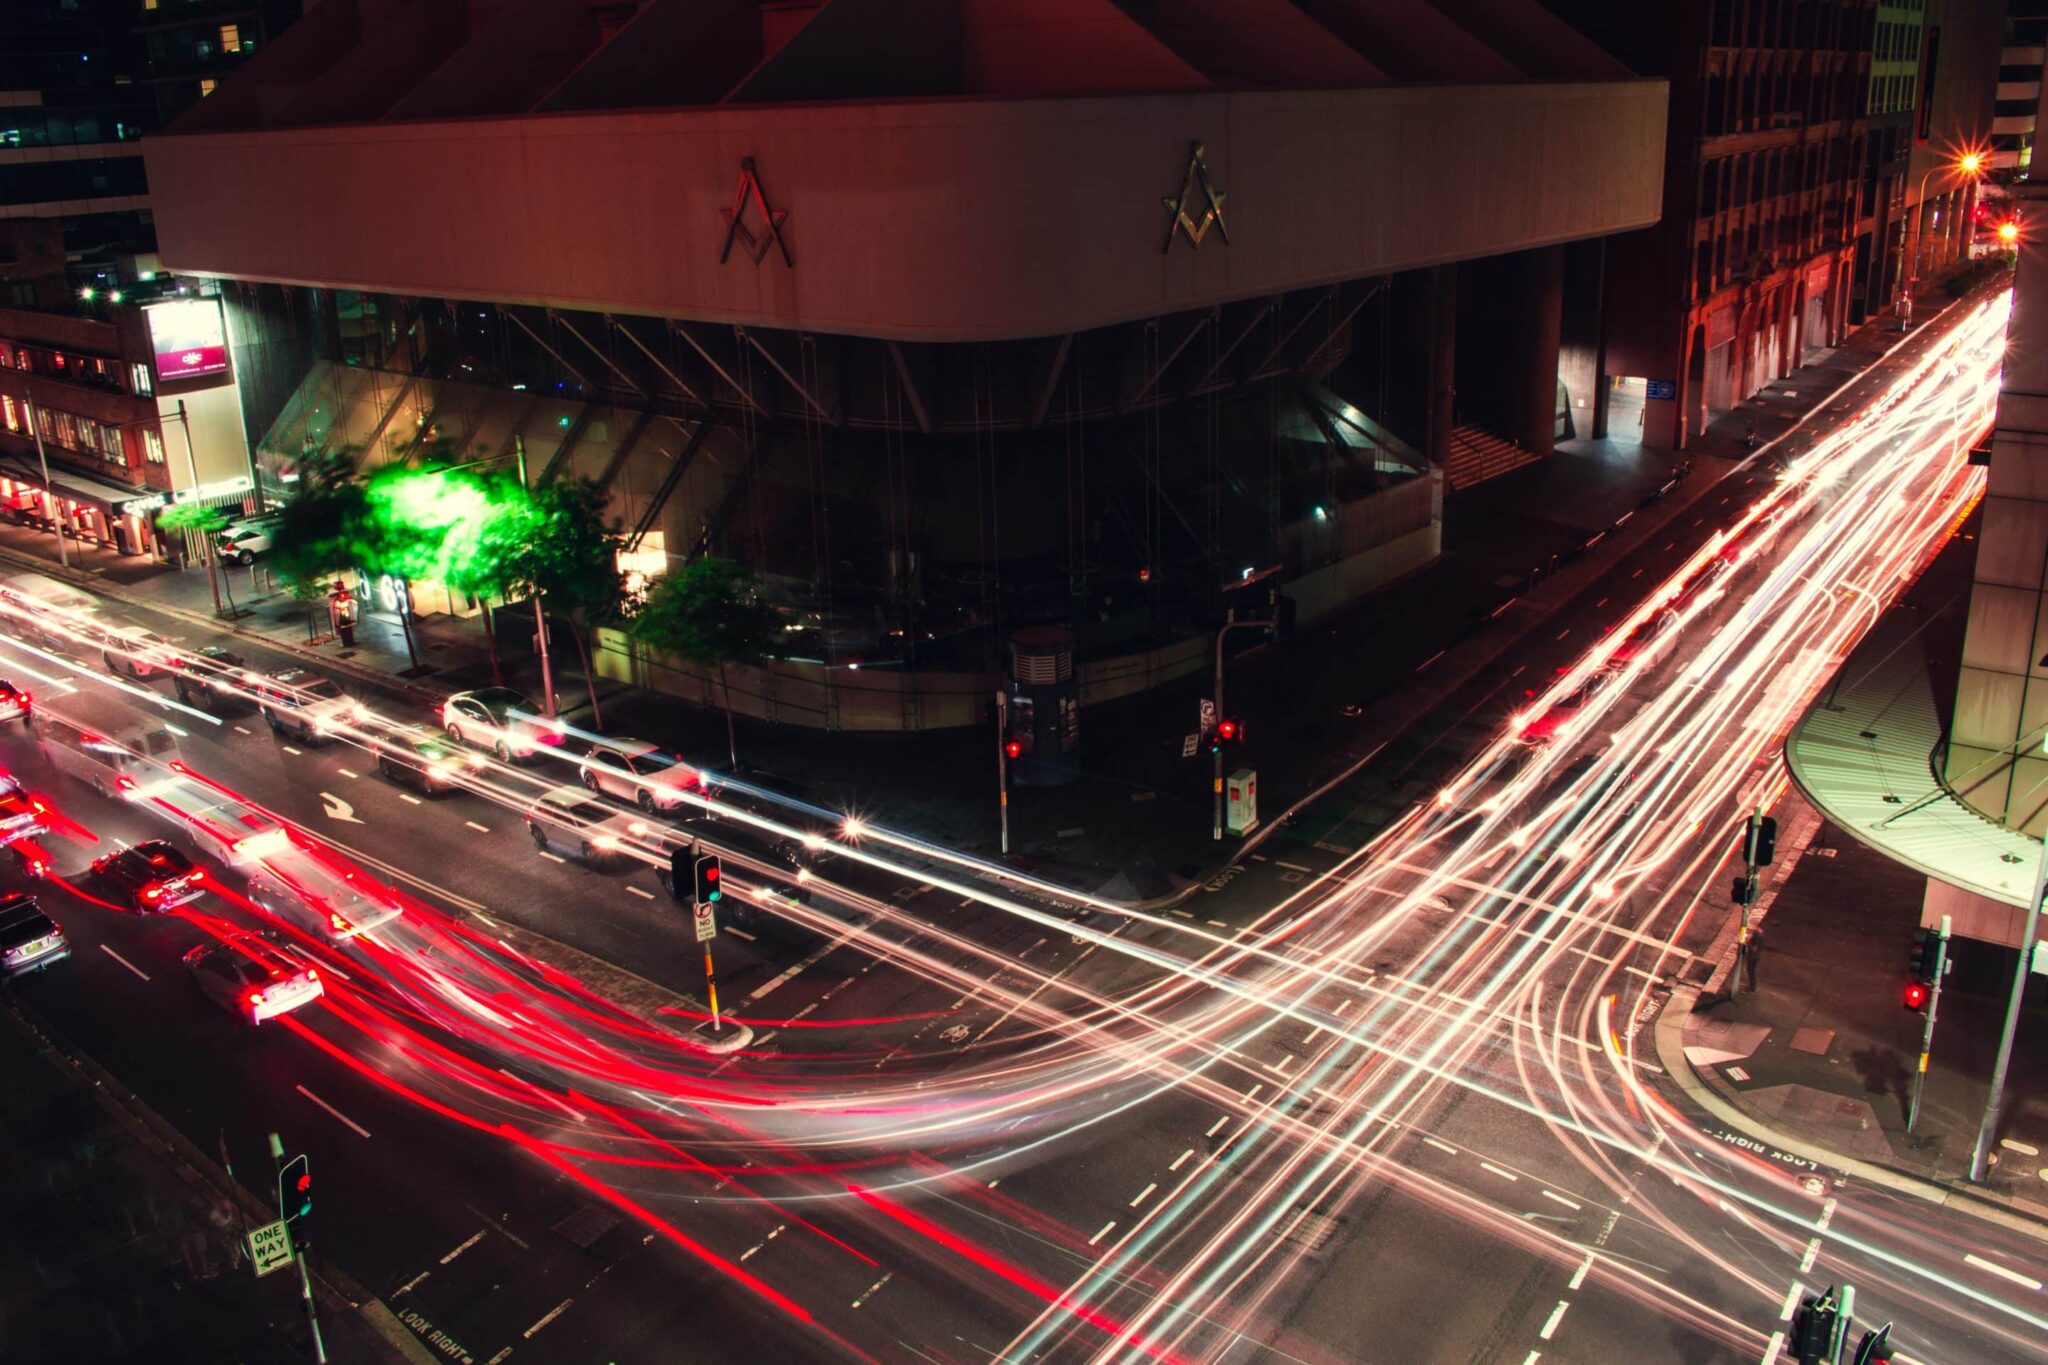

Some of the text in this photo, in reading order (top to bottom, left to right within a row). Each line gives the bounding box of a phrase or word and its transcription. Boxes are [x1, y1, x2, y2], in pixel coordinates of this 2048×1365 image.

[1713, 1131, 1818, 1171] LOOK RIGHT
[254, 1225, 281, 1244] ONE
[255, 1237, 285, 1258] WAY
[397, 1307, 468, 1359] LOOK RIGHT
